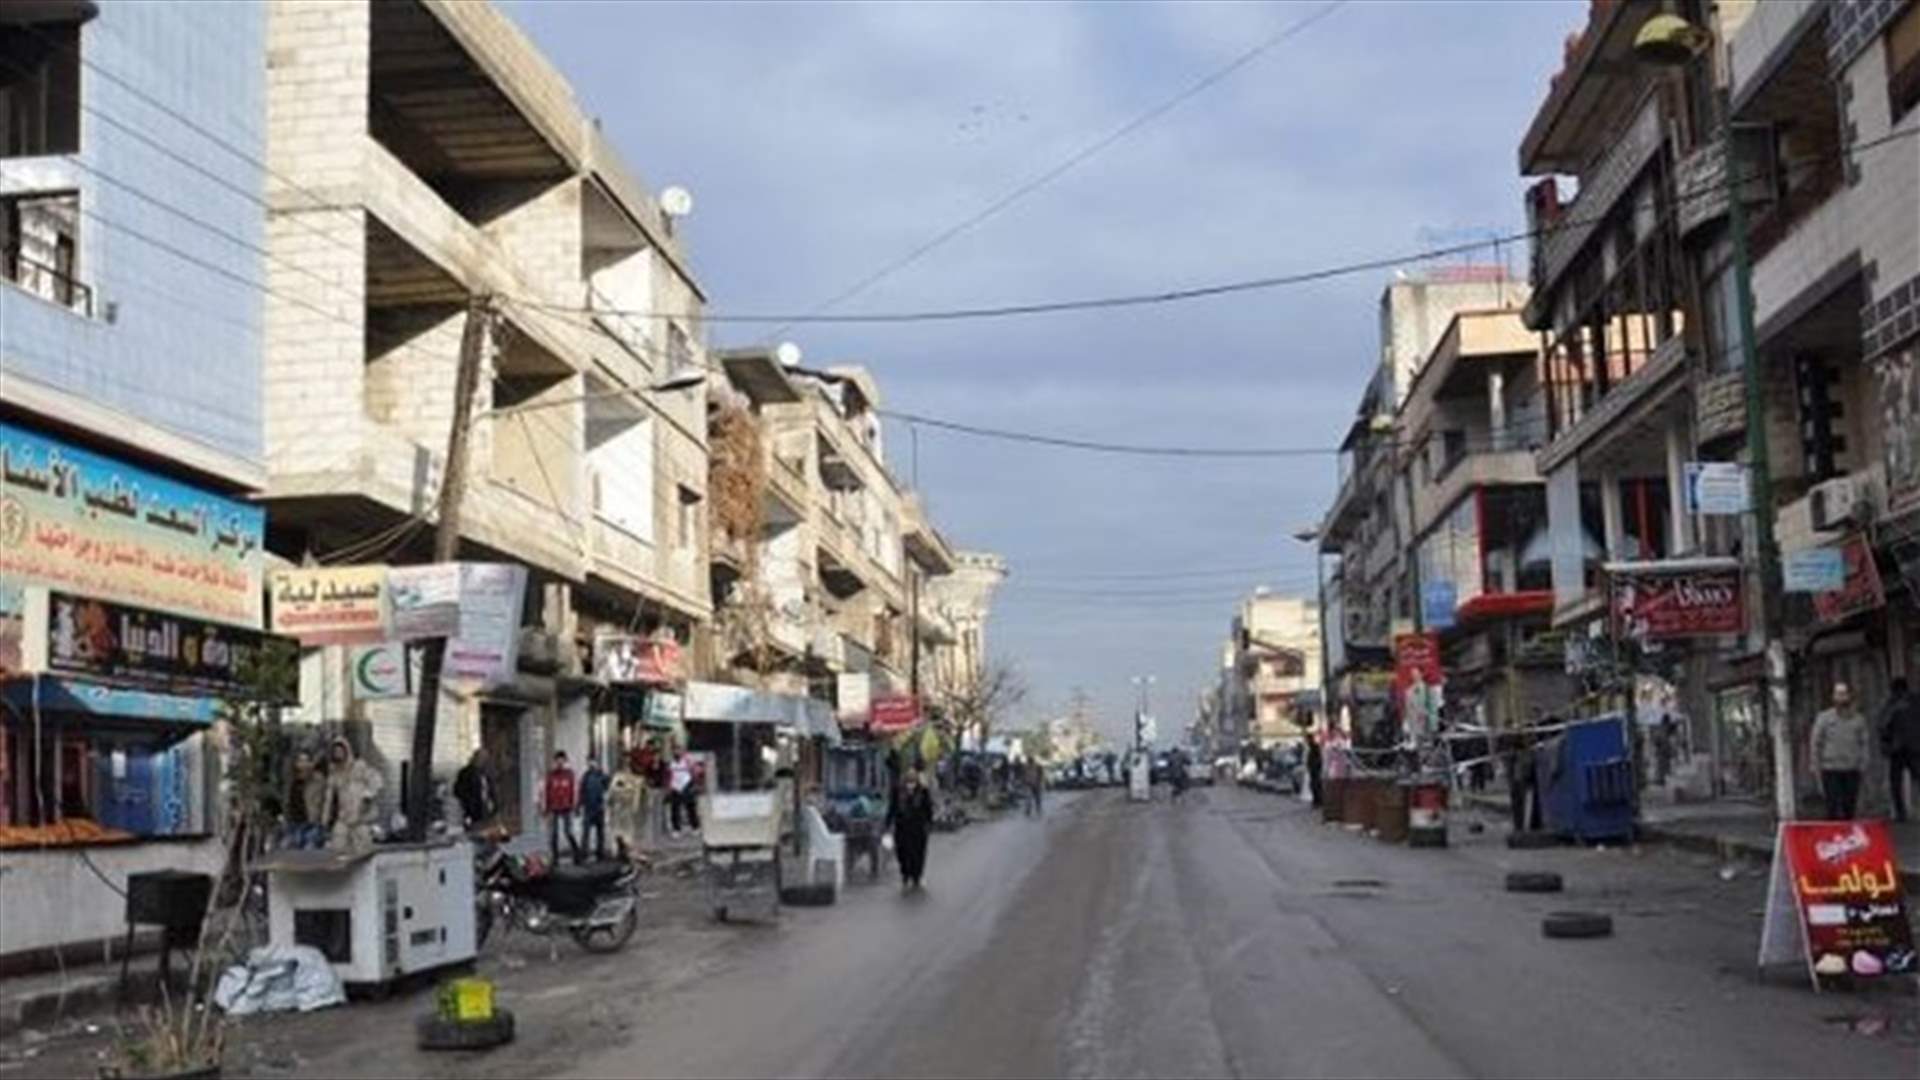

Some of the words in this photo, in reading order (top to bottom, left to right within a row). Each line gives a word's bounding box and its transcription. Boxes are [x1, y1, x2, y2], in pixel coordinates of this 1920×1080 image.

[3, 445, 79, 498] الأسنا
[210, 512, 256, 559] مركز
[276, 574, 380, 610] صيدلية
